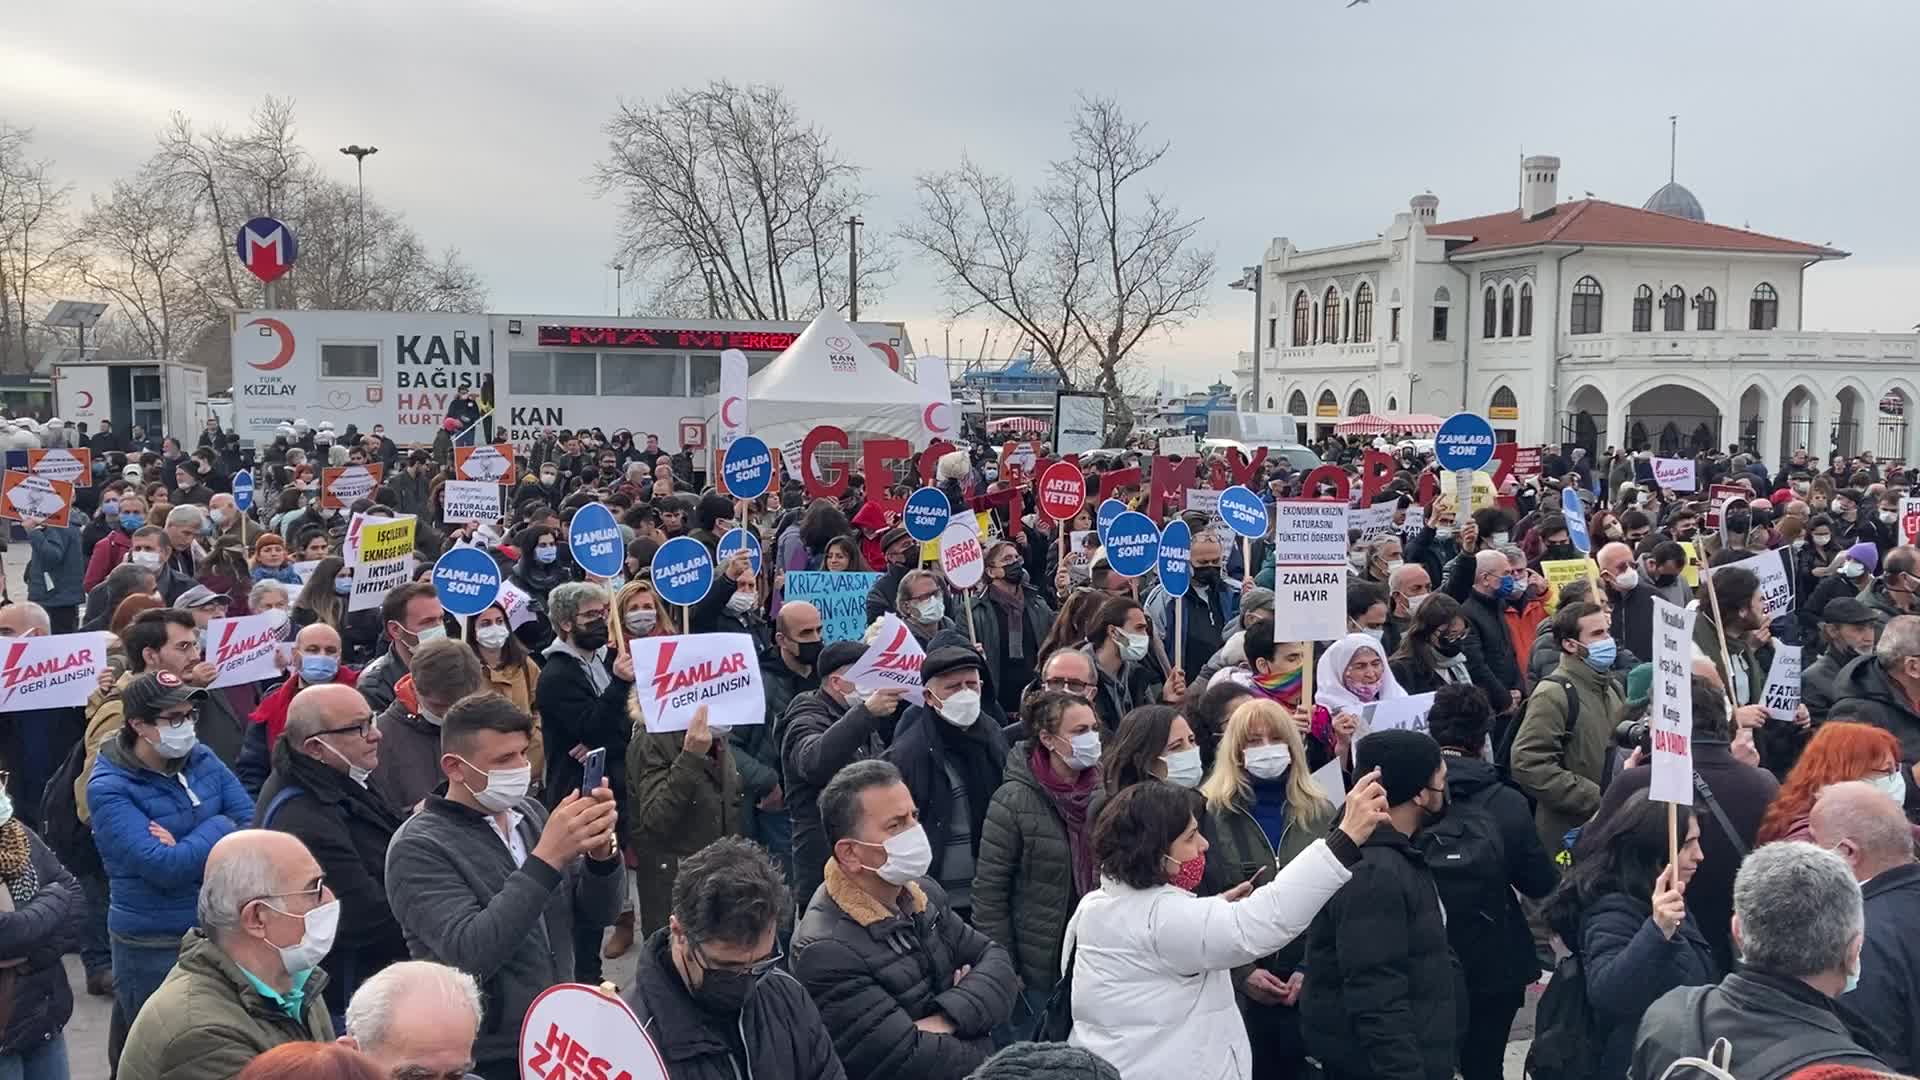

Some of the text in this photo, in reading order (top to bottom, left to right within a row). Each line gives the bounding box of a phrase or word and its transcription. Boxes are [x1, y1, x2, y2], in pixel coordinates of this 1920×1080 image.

[396, 335, 481, 365] KAN
[244, 384, 297, 396] KIZILAY
[398, 413, 444, 425] KURT
[511, 407, 563, 426] KAN
[1438, 434, 1492, 445] ZAMLARA
[1448, 446, 1478, 456] SON!
[725, 453, 769, 475] ZAMLARA
[735, 467, 761, 483] SON!
[1046, 478, 1080, 493] ARTIK
[1044, 491, 1079, 506] YETER
[447, 503, 499, 511] FATURALARI
[447, 510, 499, 520] YAKIYORUZ
[908, 504, 948, 518] ZAMLARA
[1221, 499, 1265, 520] ZAMLARA
[914, 515, 937, 527] SON!
[1231, 510, 1256, 525] SON!
[1292, 520, 1334, 529] FATURASINI
[574, 527, 619, 547] ZAMLARA
[1108, 532, 1158, 548] ZAMLARA
[944, 539, 975, 557] HESAP
[1118, 545, 1144, 559] SON!
[655, 556, 708, 580] ZAMLARA
[945, 550, 980, 572] ZAMANI
[436, 566, 497, 586] ZAMLARA
[670, 571, 699, 588] SON!
[1283, 573, 1339, 585] ZAMLARA
[446, 581, 480, 597] SON!
[1293, 590, 1328, 602] HAYIR
[217, 625, 277, 665] ZAMLAR
[2, 646, 92, 692] ZAMLAR
[225, 657, 244, 673] GERİ
[49, 666, 95, 687] ALINSIN
[651, 647, 747, 705] ZAMLAR
[20, 677, 48, 695] GERİ
[700, 675, 751, 700] ALINSIN
[671, 692, 699, 709] GERİ
